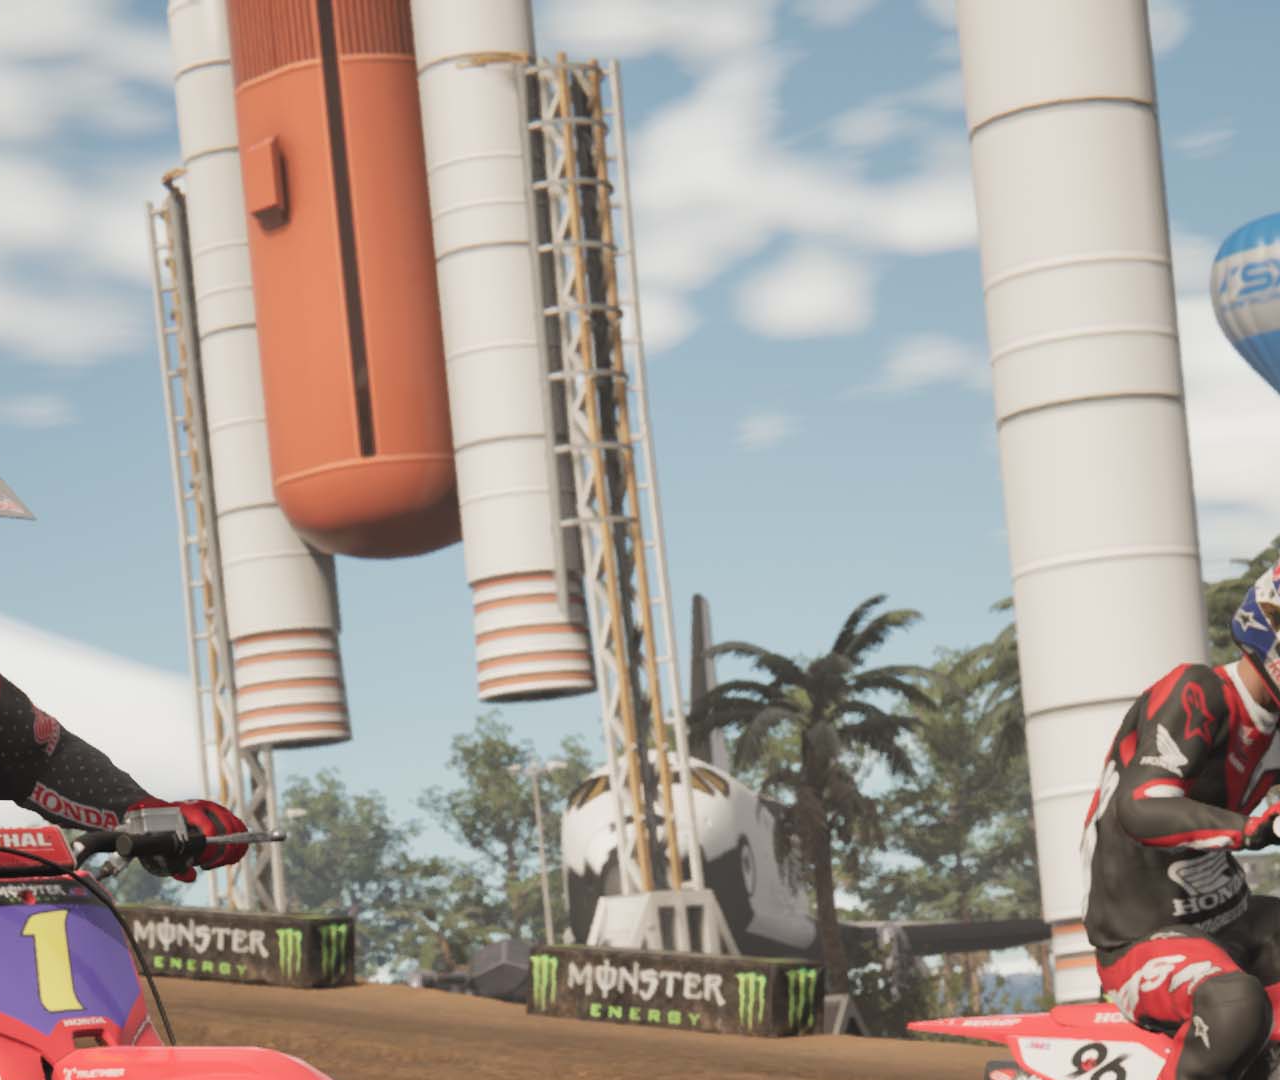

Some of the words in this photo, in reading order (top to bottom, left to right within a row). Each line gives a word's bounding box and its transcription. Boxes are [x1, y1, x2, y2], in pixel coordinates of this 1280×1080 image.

[31, 783, 119, 832] HONDA
[133, 917, 269, 958] MONSTER
[22, 909, 86, 1014] 1
[153, 955, 247, 976] ENERGY
[567, 959, 726, 1006] MONSTER
[589, 1003, 701, 1026] ENERGY
